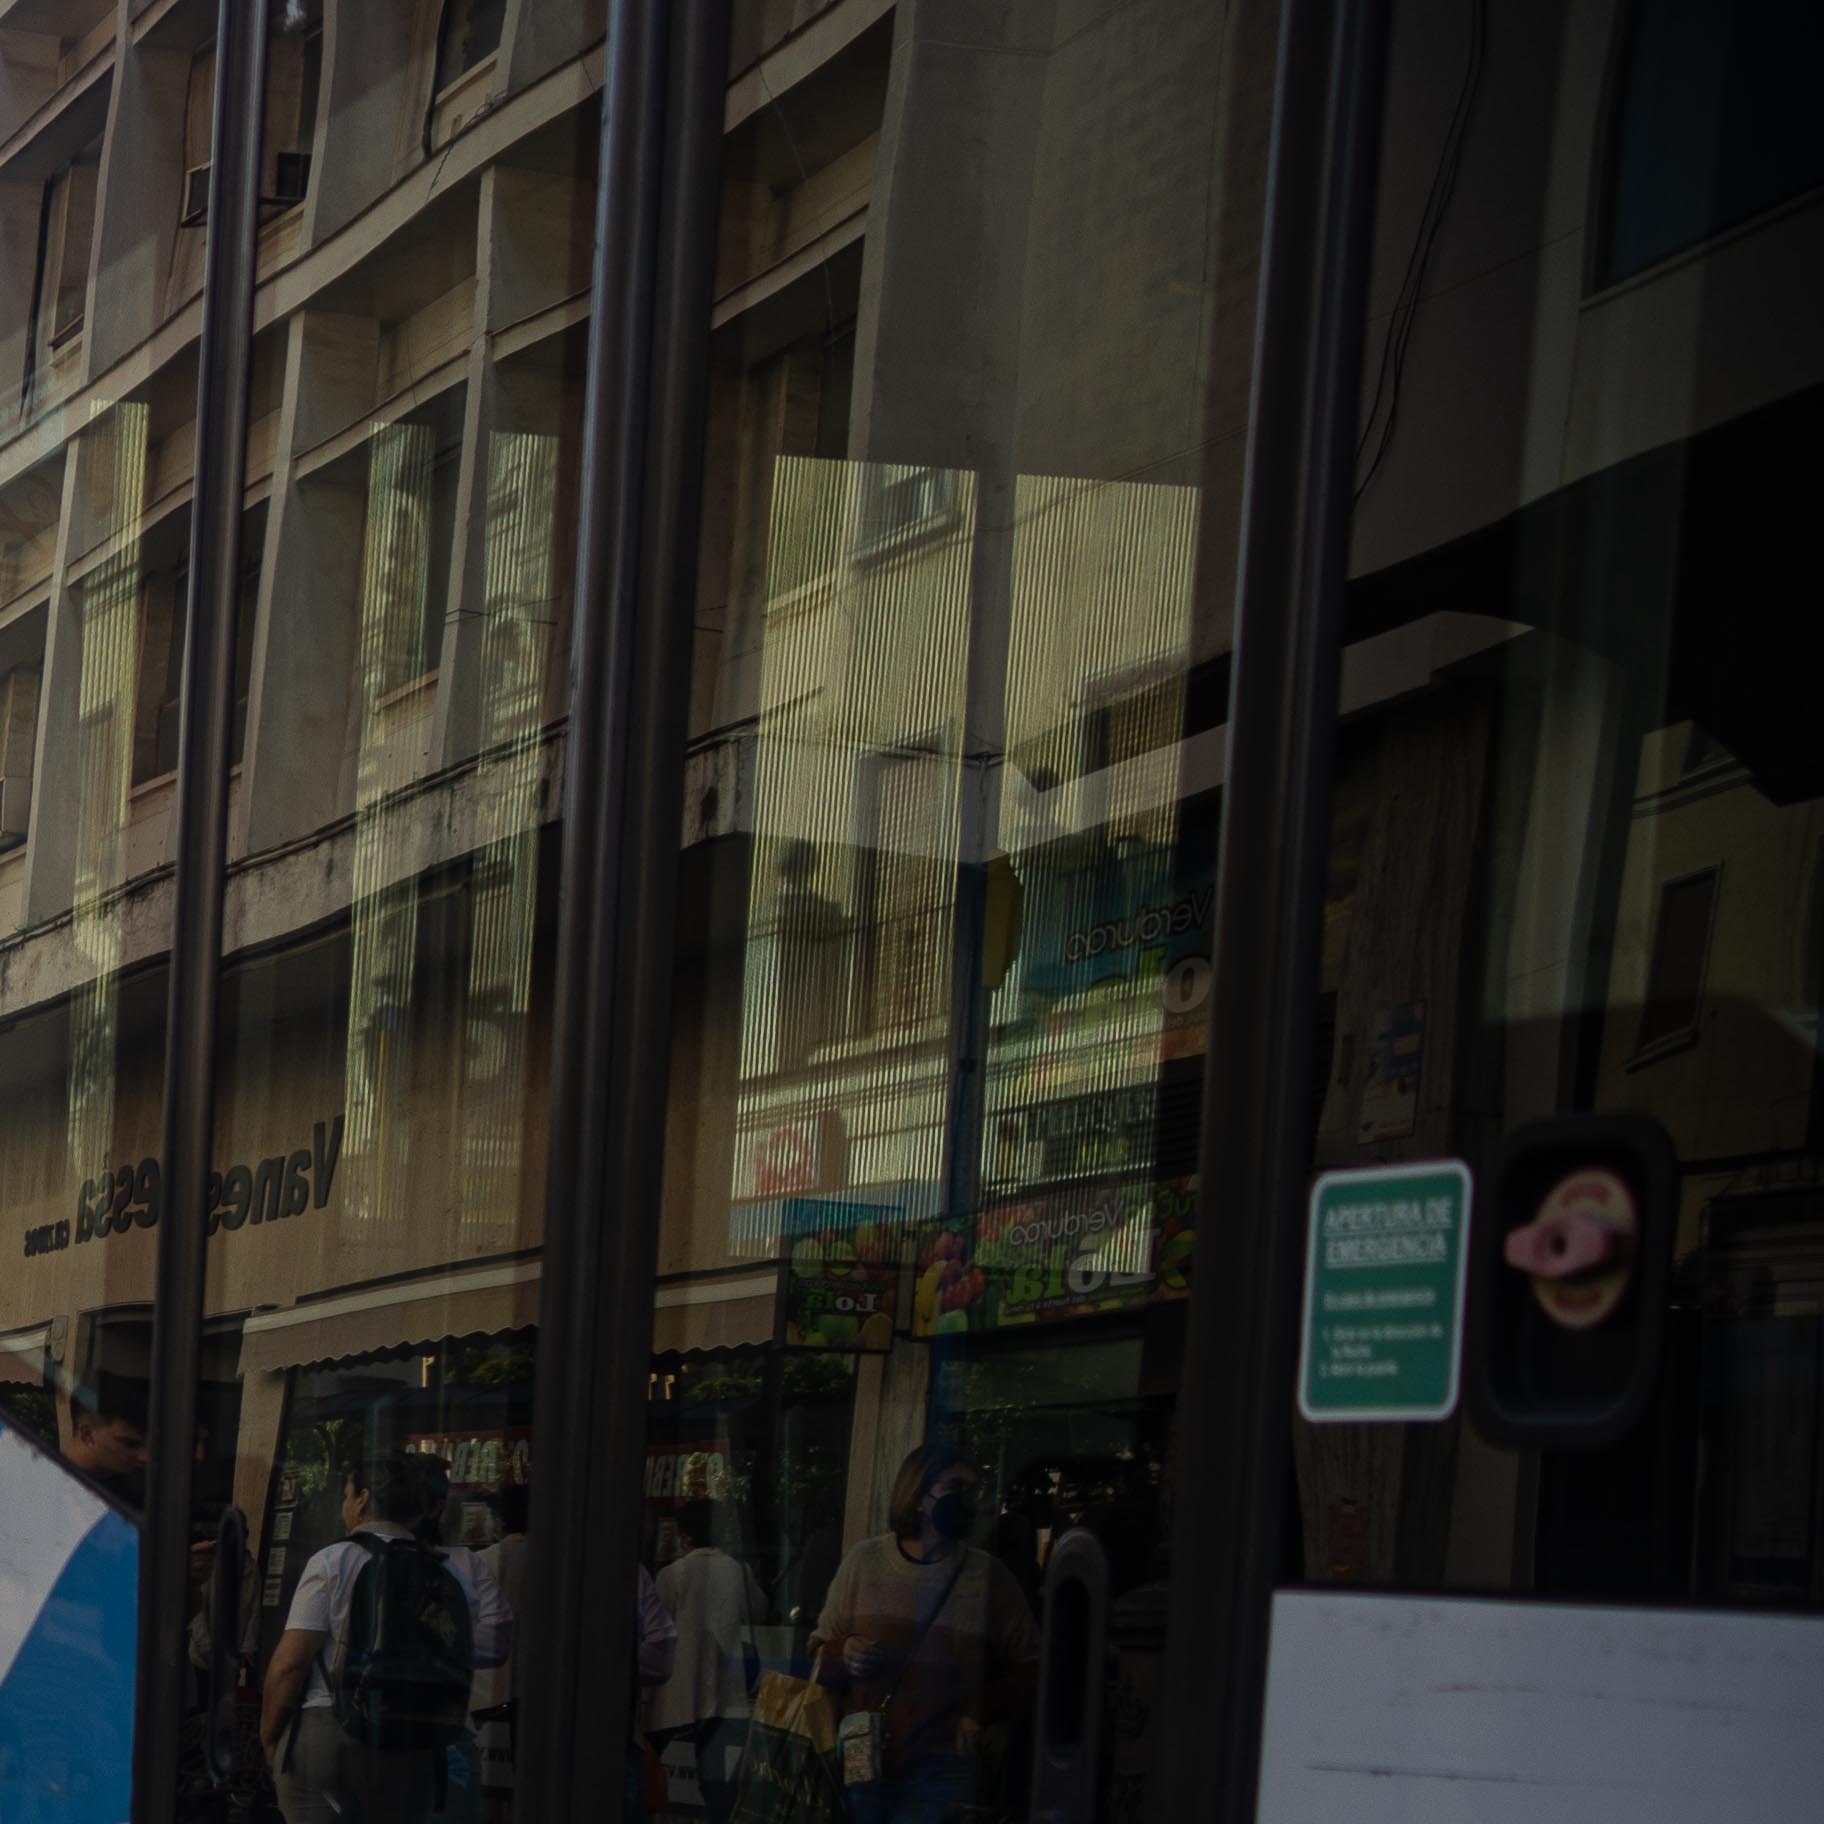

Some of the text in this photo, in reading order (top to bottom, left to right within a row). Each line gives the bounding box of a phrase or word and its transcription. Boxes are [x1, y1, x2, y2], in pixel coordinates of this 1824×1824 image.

[1325, 1197, 1451, 1233] APERTURA DE
[1326, 1232, 1447, 1264] EMERGENCIA
